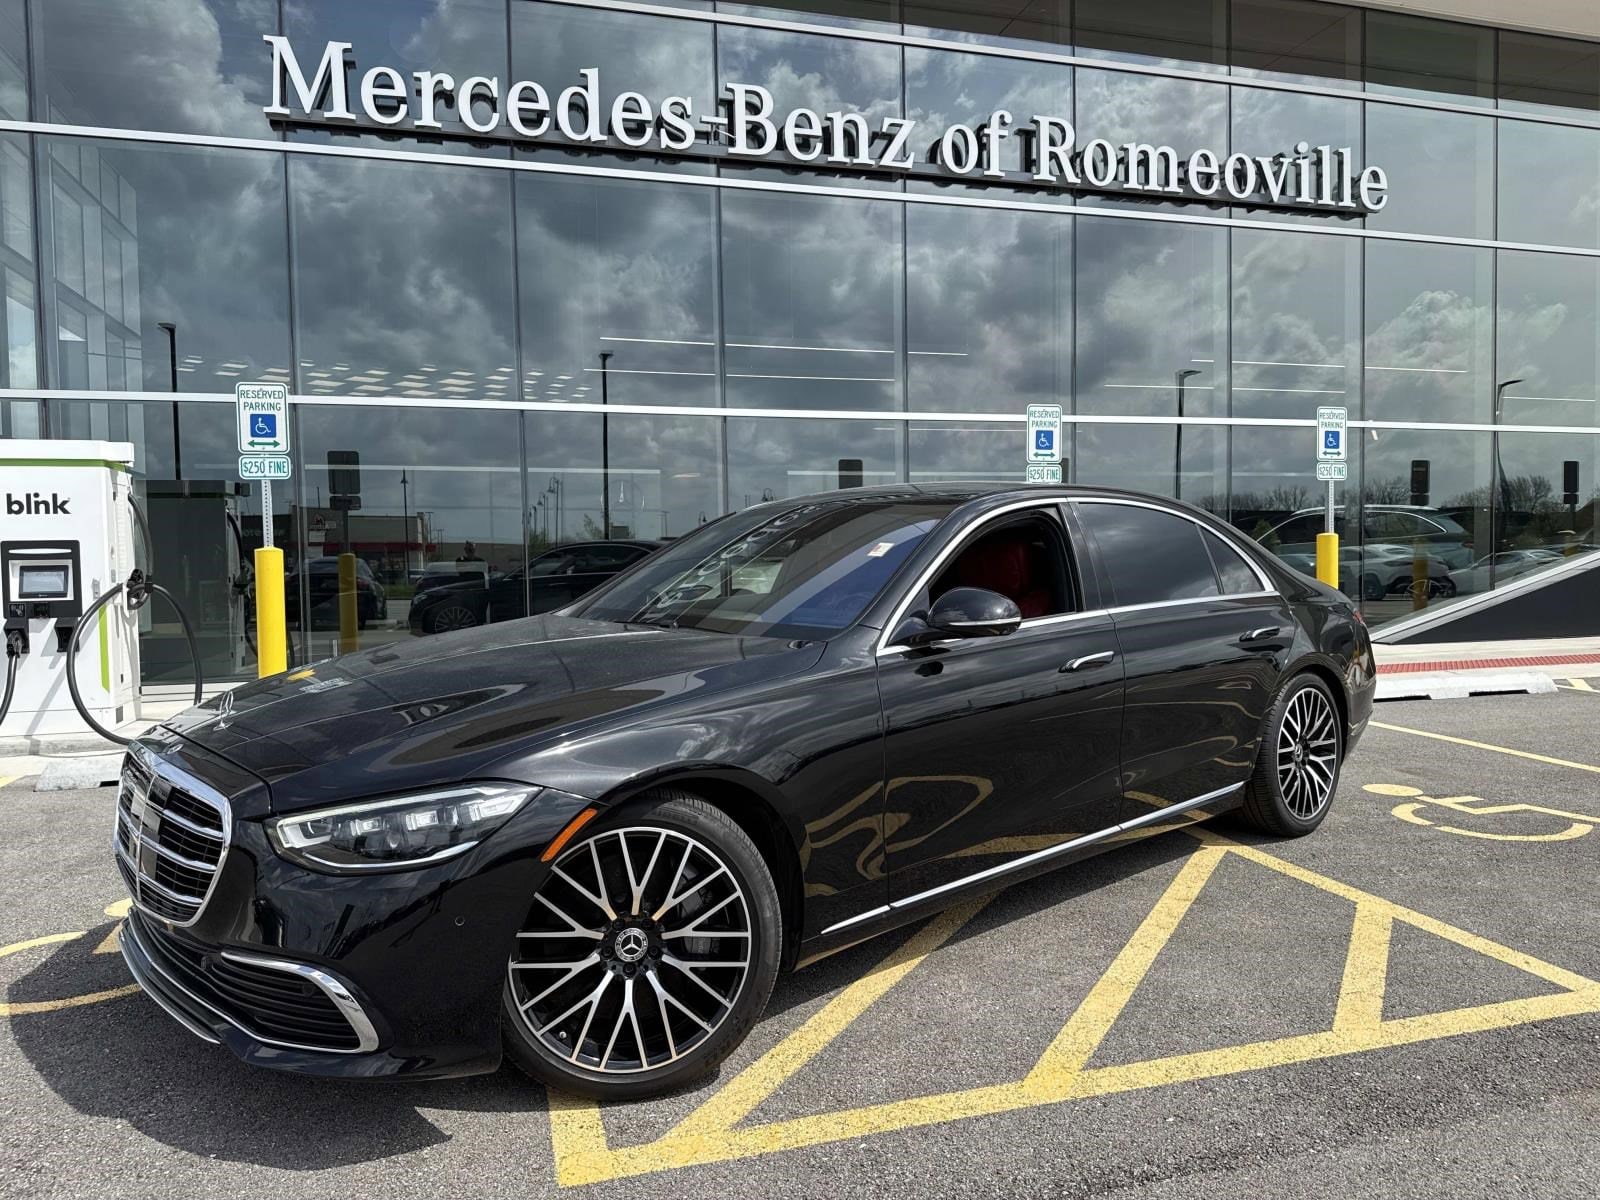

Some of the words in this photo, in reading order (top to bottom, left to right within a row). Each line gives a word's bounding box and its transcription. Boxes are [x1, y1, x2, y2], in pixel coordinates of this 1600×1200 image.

[262, 34, 916, 169] Mercedes-Benz
[942, 109, 1013, 177] of
[1032, 114, 1389, 211] Romeoville
[240, 389, 284, 399] RESERVED
[243, 402, 281, 411] PARKING
[1029, 410, 1060, 419] RESERVED
[1031, 420, 1058, 428] PARKING
[1320, 421, 1344, 429] PARKING
[243, 460, 266, 474] $250
[268, 461, 288, 474] FINE
[1333, 466, 1345, 477] FINE
[1029, 468, 1045, 480] $250
[1046, 469, 1059, 480] FINE
[6, 492, 71, 515] blink
